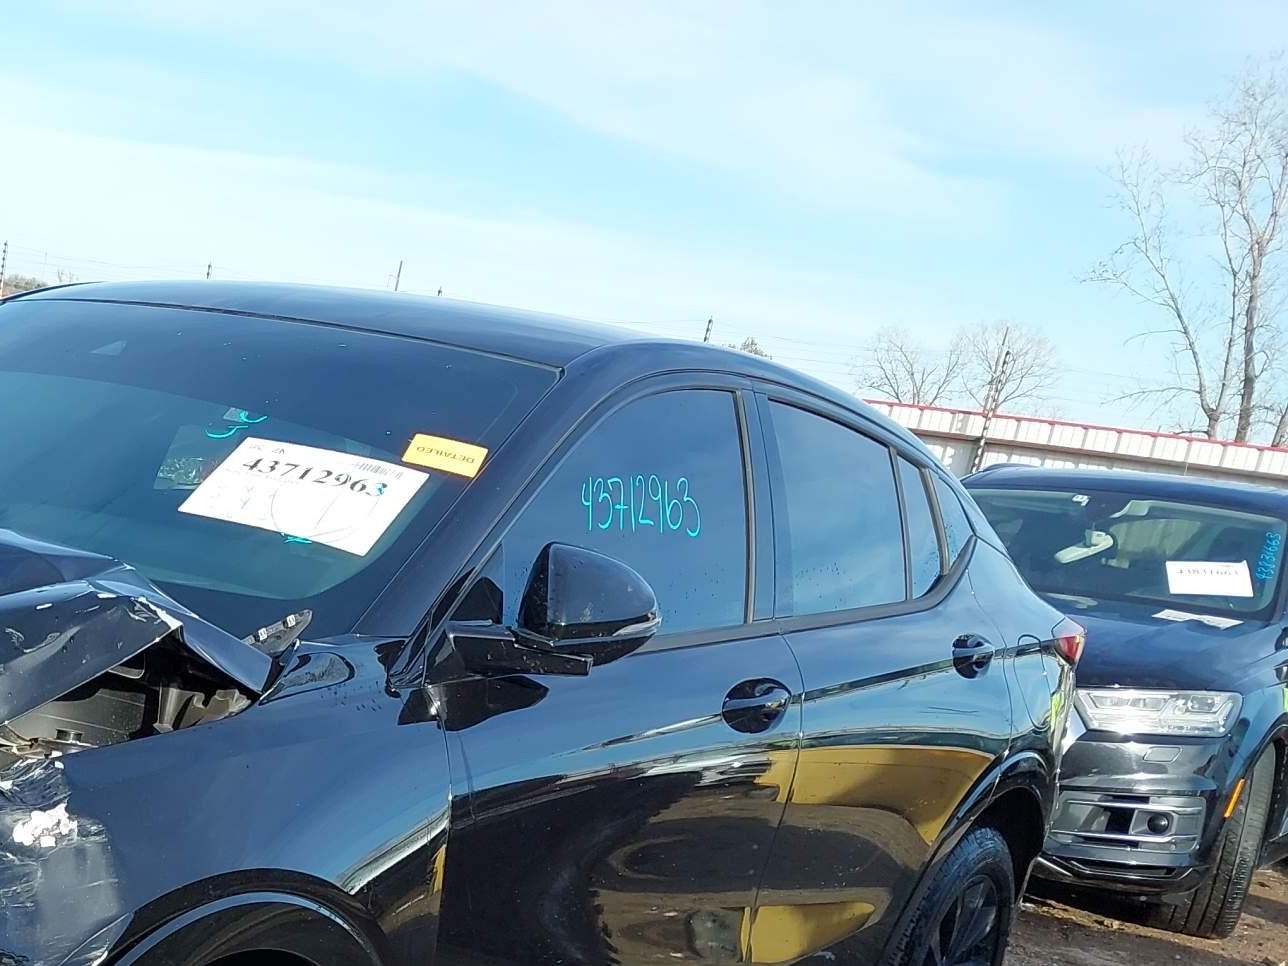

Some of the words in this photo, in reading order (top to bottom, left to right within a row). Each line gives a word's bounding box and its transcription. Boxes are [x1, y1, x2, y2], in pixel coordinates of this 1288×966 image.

[416, 446, 476, 464] DETAILED
[243, 458, 388, 497] 43712963
[581, 475, 701, 537] 43712963
